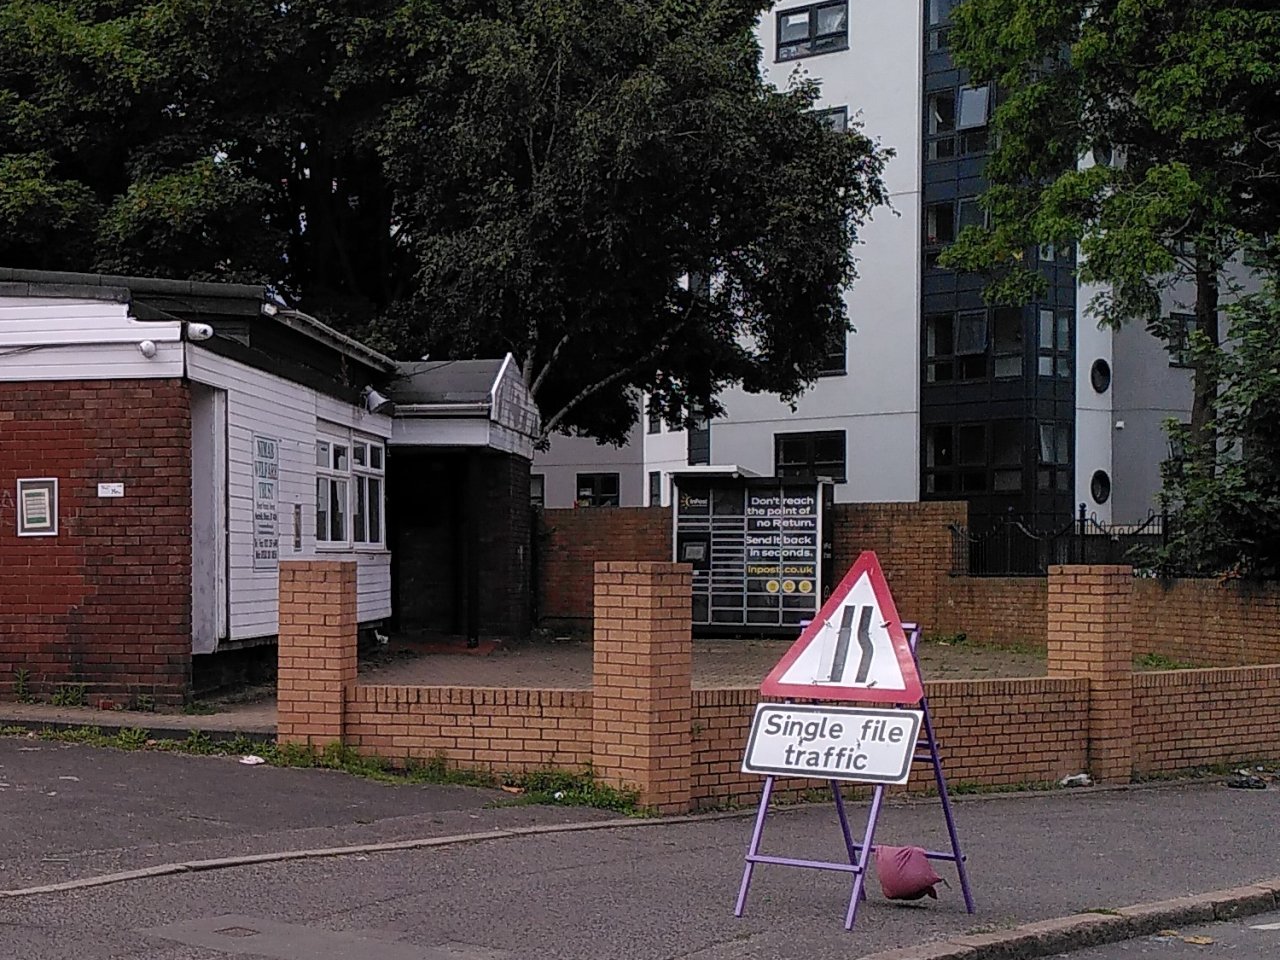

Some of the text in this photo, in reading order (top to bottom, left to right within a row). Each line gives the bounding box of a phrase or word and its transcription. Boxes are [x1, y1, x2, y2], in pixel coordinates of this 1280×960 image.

[751, 496, 814, 505] Don't reach
[747, 506, 811, 517] the point of
[772, 519, 815, 527] Return.
[746, 535, 812, 544] Send it back
[761, 547, 813, 557] seconds.
[764, 713, 904, 744] Single file
[784, 744, 868, 771] traffic
